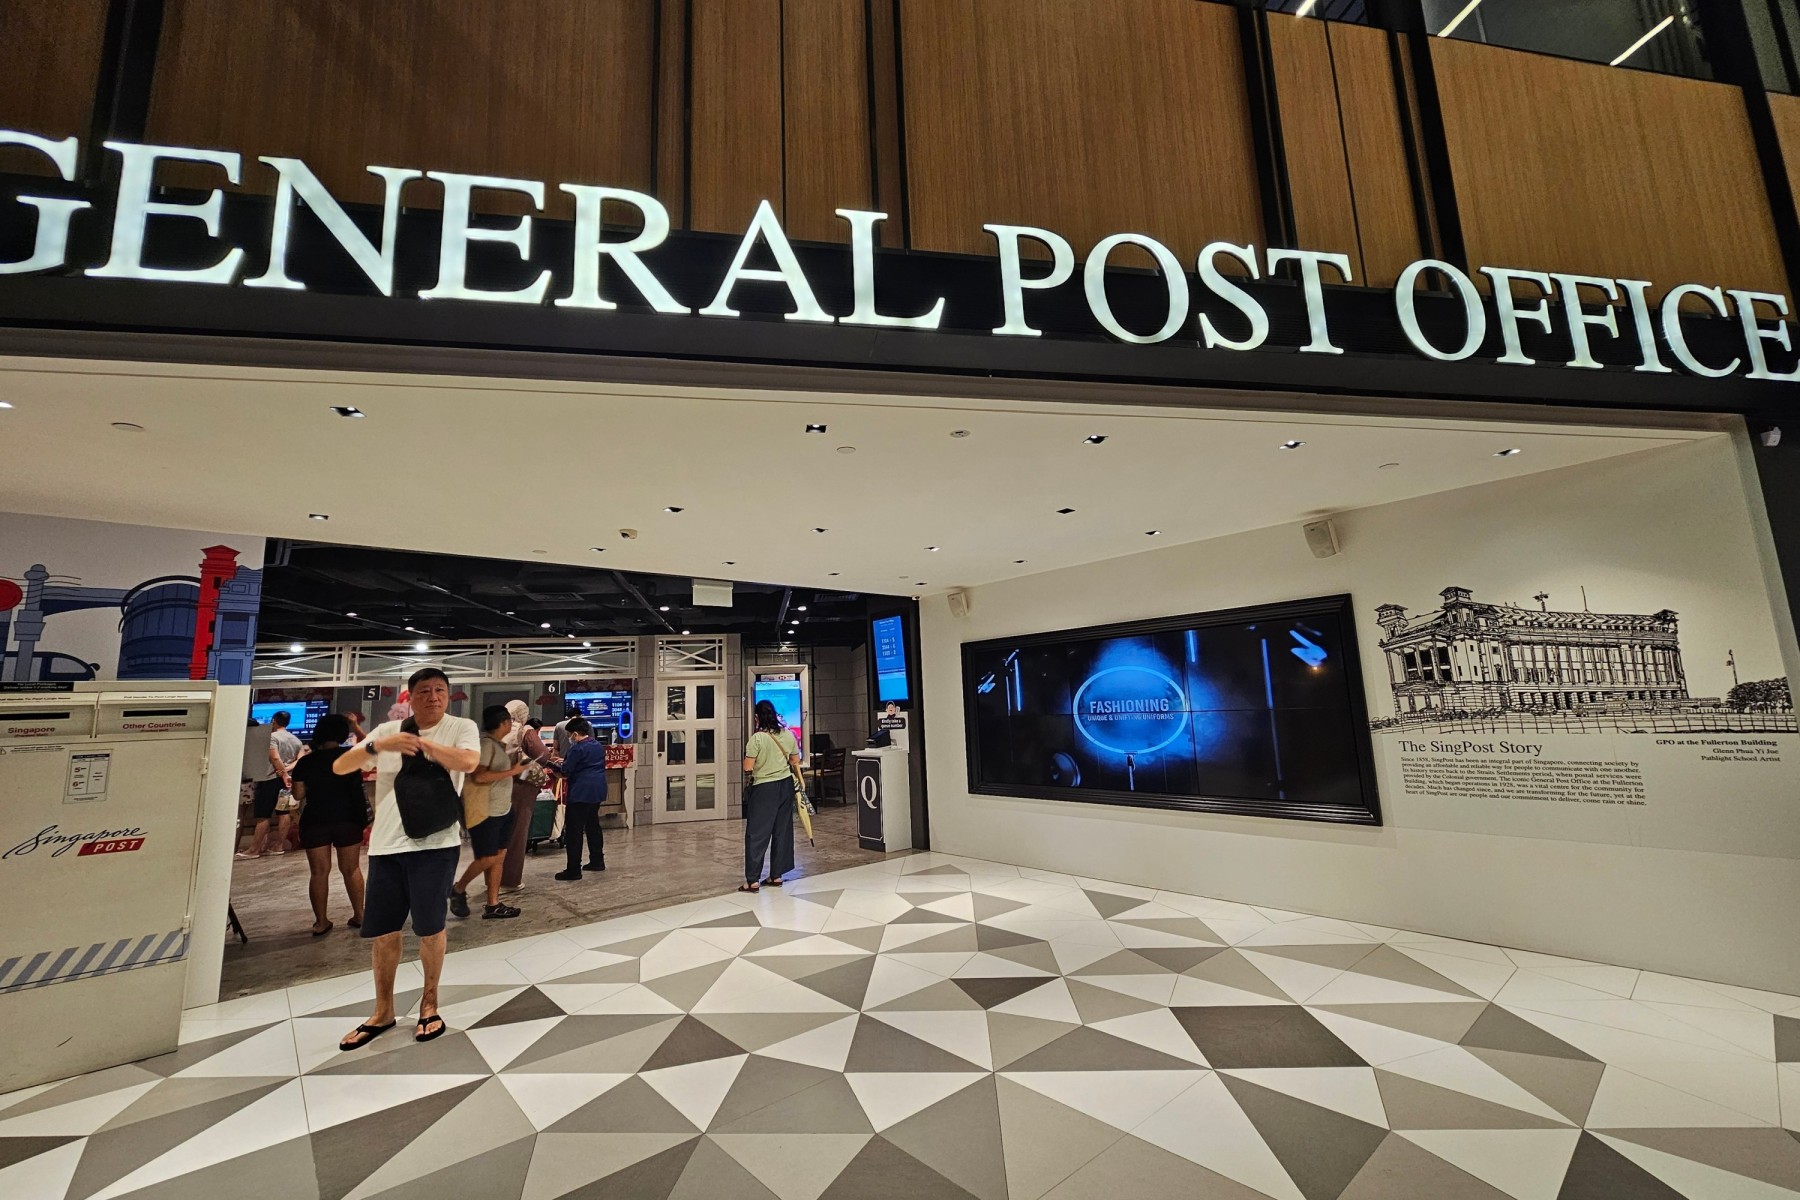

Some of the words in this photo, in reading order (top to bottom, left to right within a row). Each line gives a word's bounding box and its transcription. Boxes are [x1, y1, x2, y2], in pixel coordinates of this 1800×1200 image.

[0, 129, 946, 330] GENERAL
[983, 224, 1353, 354] POST
[1395, 258, 1800, 381] OFFICE
[368, 688, 375, 698] 5
[548, 682, 555, 693] 6
[1090, 698, 1169, 713] FASHIONING
[1398, 741, 1426, 752] The
[1431, 741, 1495, 755] SingPost
[1500, 741, 1543, 756] Story
[861, 776, 877, 809] Q
[2, 825, 148, 859] Singapore
[93, 840, 138, 853] POST
